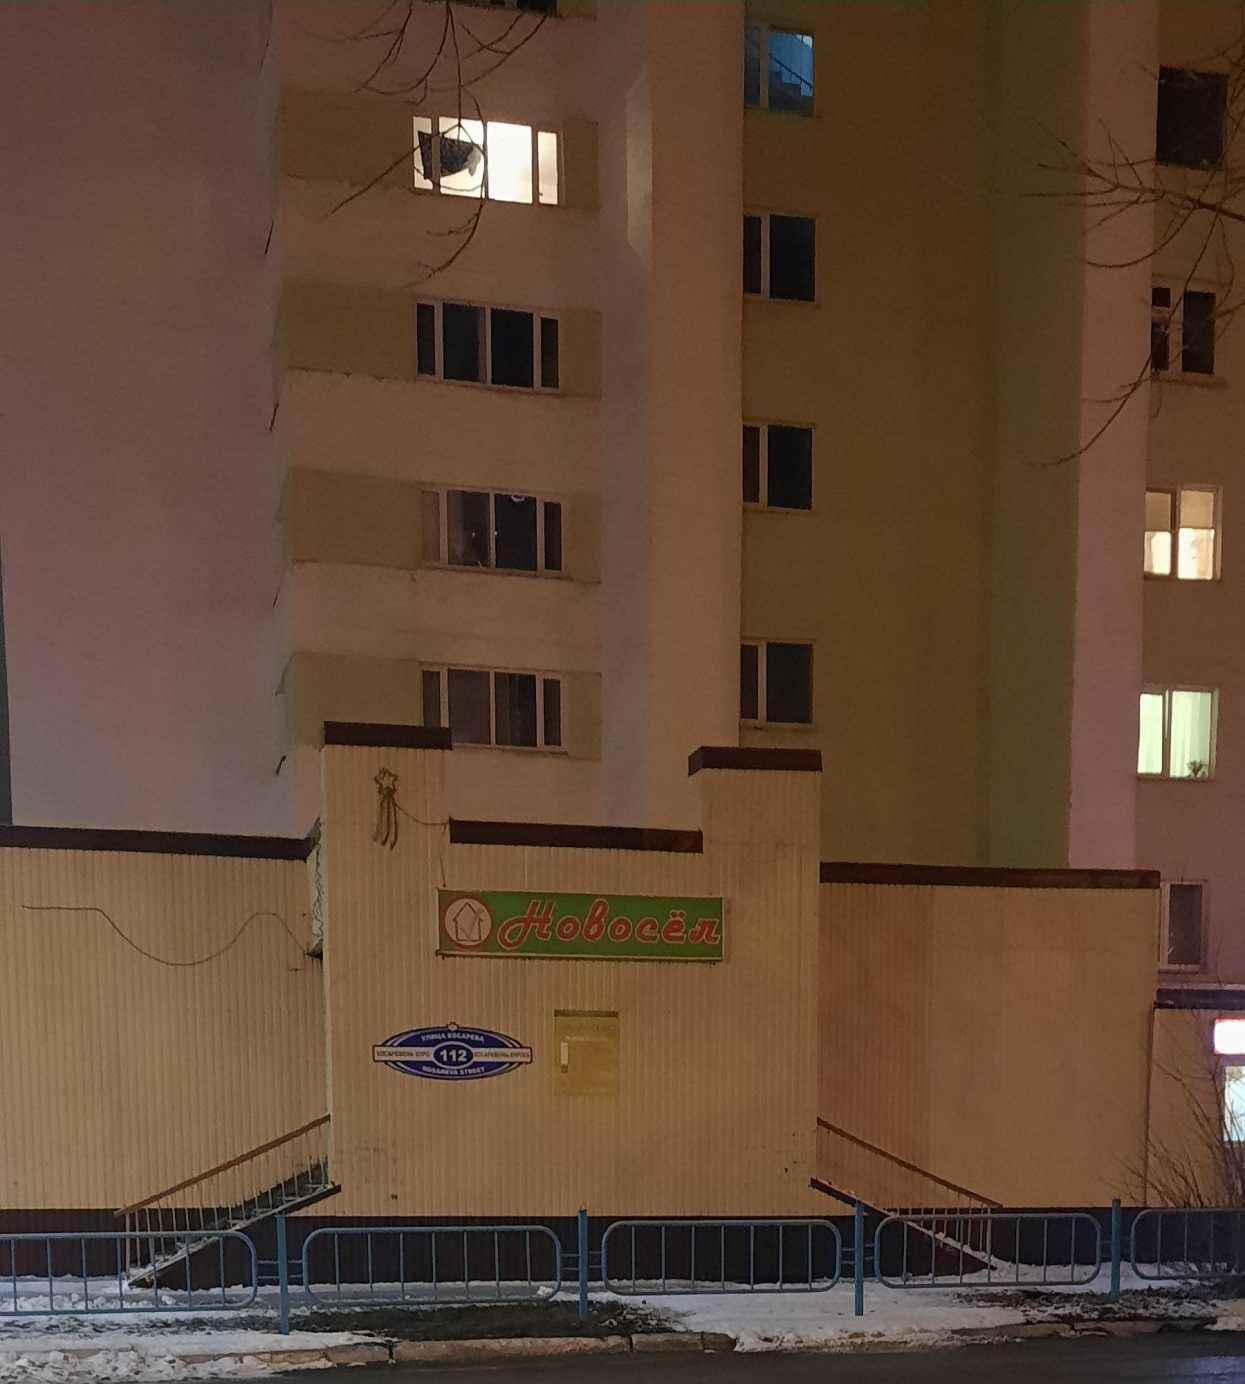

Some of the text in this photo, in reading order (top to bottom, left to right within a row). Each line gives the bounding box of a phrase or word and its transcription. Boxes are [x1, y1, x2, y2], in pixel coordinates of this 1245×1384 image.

[497, 898, 720, 951] Новосёл
[421, 1031, 485, 1042] УЛИЦА КОСАРЕВА
[440, 1049, 467, 1062] 112
[459, 1066, 485, 1076] STREET
